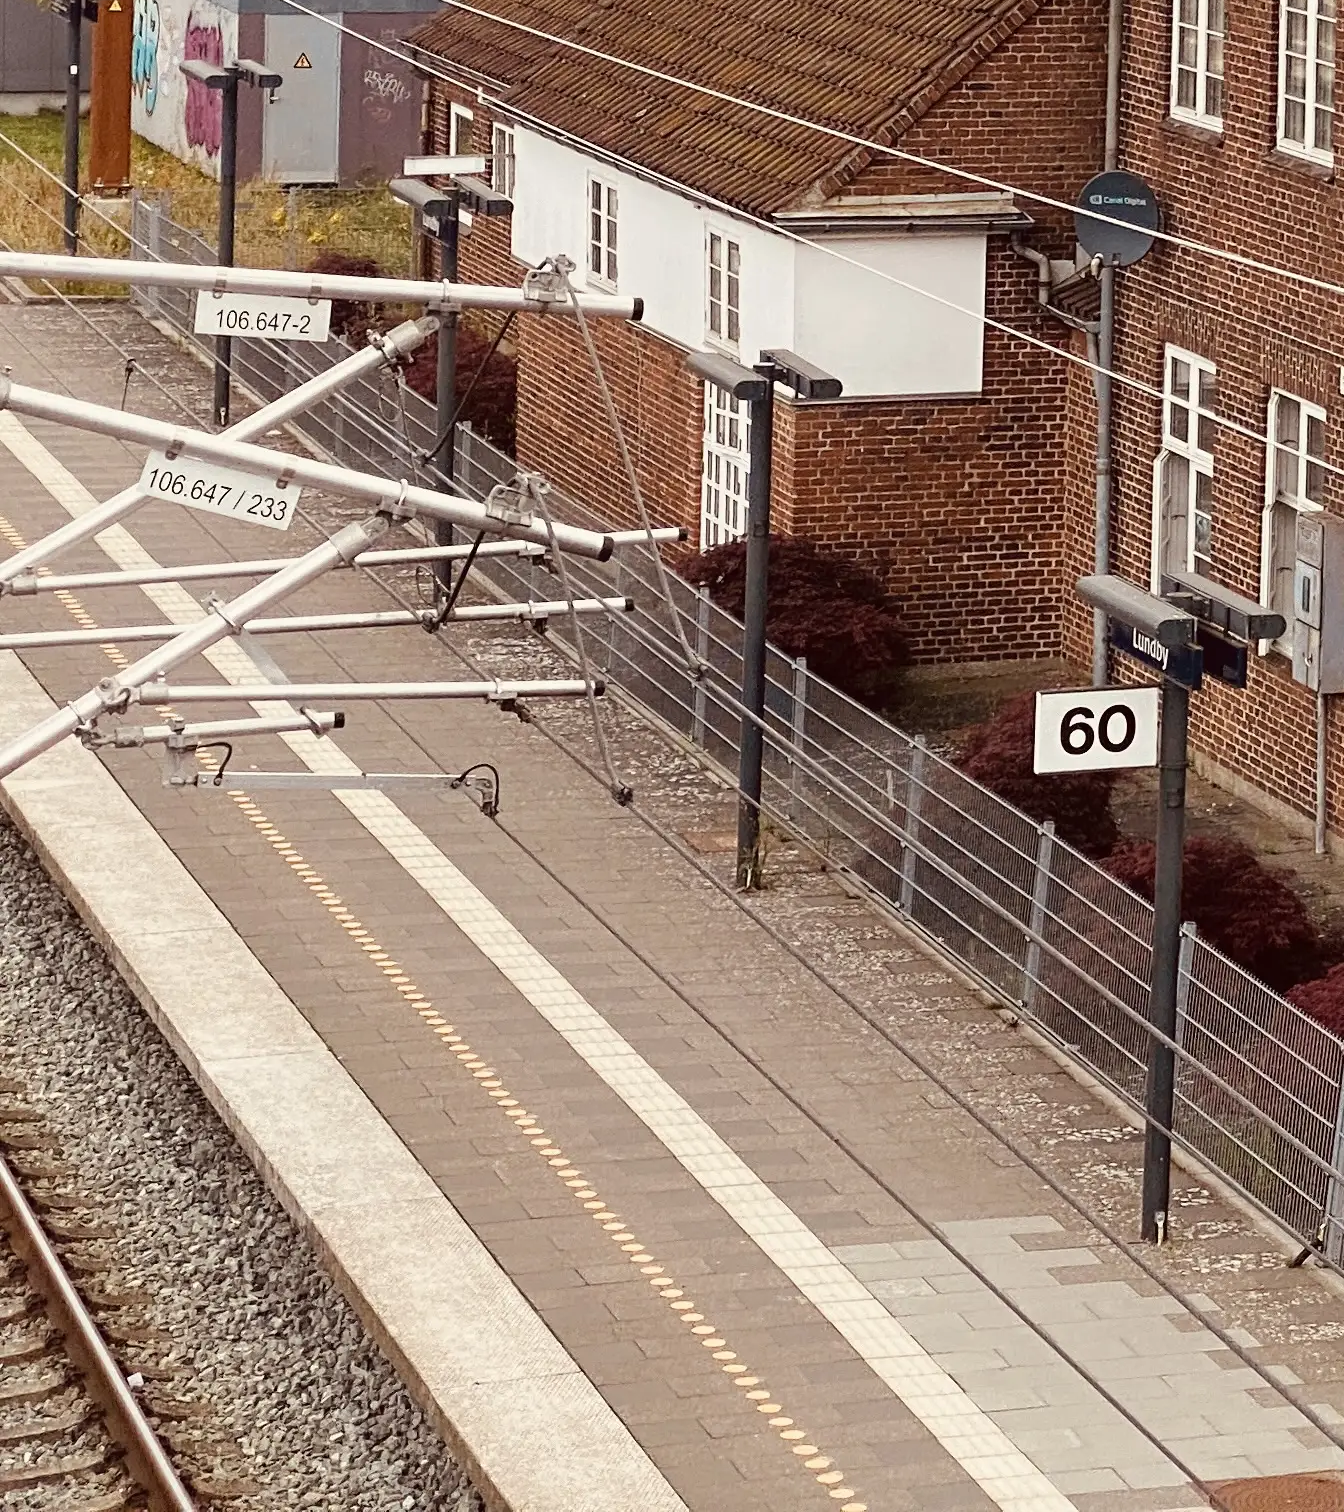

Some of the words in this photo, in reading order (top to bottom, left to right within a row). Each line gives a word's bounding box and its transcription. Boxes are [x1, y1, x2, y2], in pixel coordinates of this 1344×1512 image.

[216, 309, 311, 334] 106.647-2
[149, 468, 232, 506] 106.647
[246, 494, 288, 521] 233
[1132, 627, 1169, 671] Lundby
[1060, 704, 1136, 755] 60
